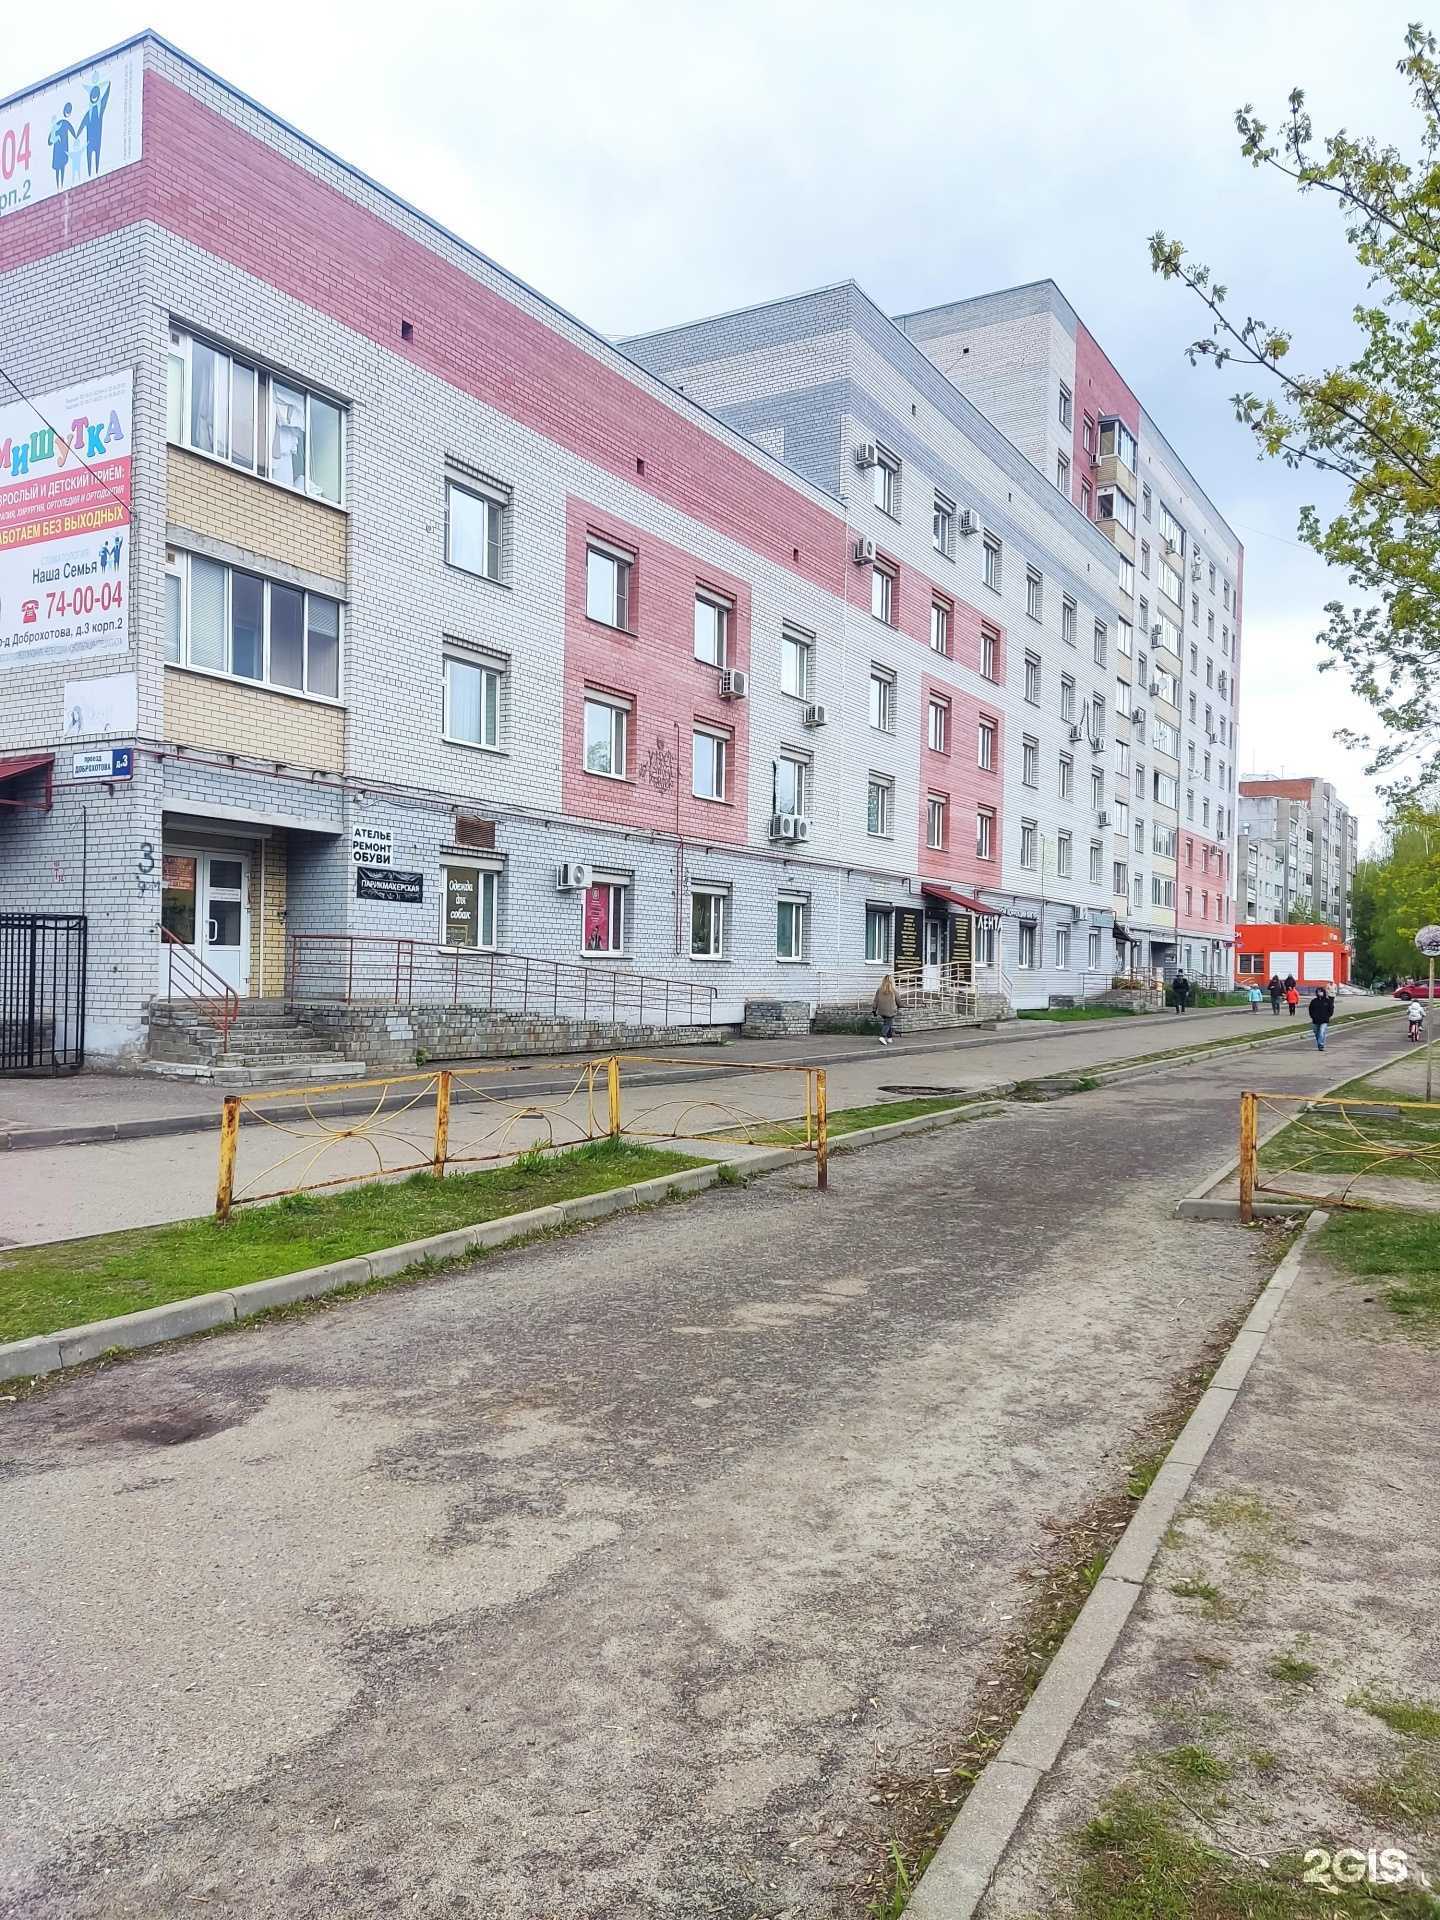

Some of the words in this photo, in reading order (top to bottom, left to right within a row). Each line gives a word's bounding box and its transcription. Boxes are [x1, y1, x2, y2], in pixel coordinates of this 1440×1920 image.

[40, 483, 47, 497] И
[47, 471, 89, 498] ДЕТСКИЙ
[42, 519, 62, 536] БЕЗ
[64, 506, 124, 531] ВЫХОДНЫХ
[32, 567, 60, 584] Наша
[63, 561, 97, 578] Семья
[46, 580, 123, 619] 74-00-04
[12, 627, 73, 648] Доброхотова,
[76, 622, 90, 636] д.3
[92, 617, 123, 634] корп.2
[115, 754, 128, 769] д.3
[354, 828, 392, 841] АТЕЛЬЕ
[352, 840, 392, 853] РЕМОНТ
[353, 851, 391, 865] ОБУВИ
[361, 880, 420, 892] ПАРИКМАХЕРСКАЯ
[448, 879, 474, 892] Одежда
[450, 907, 472, 920] собак
